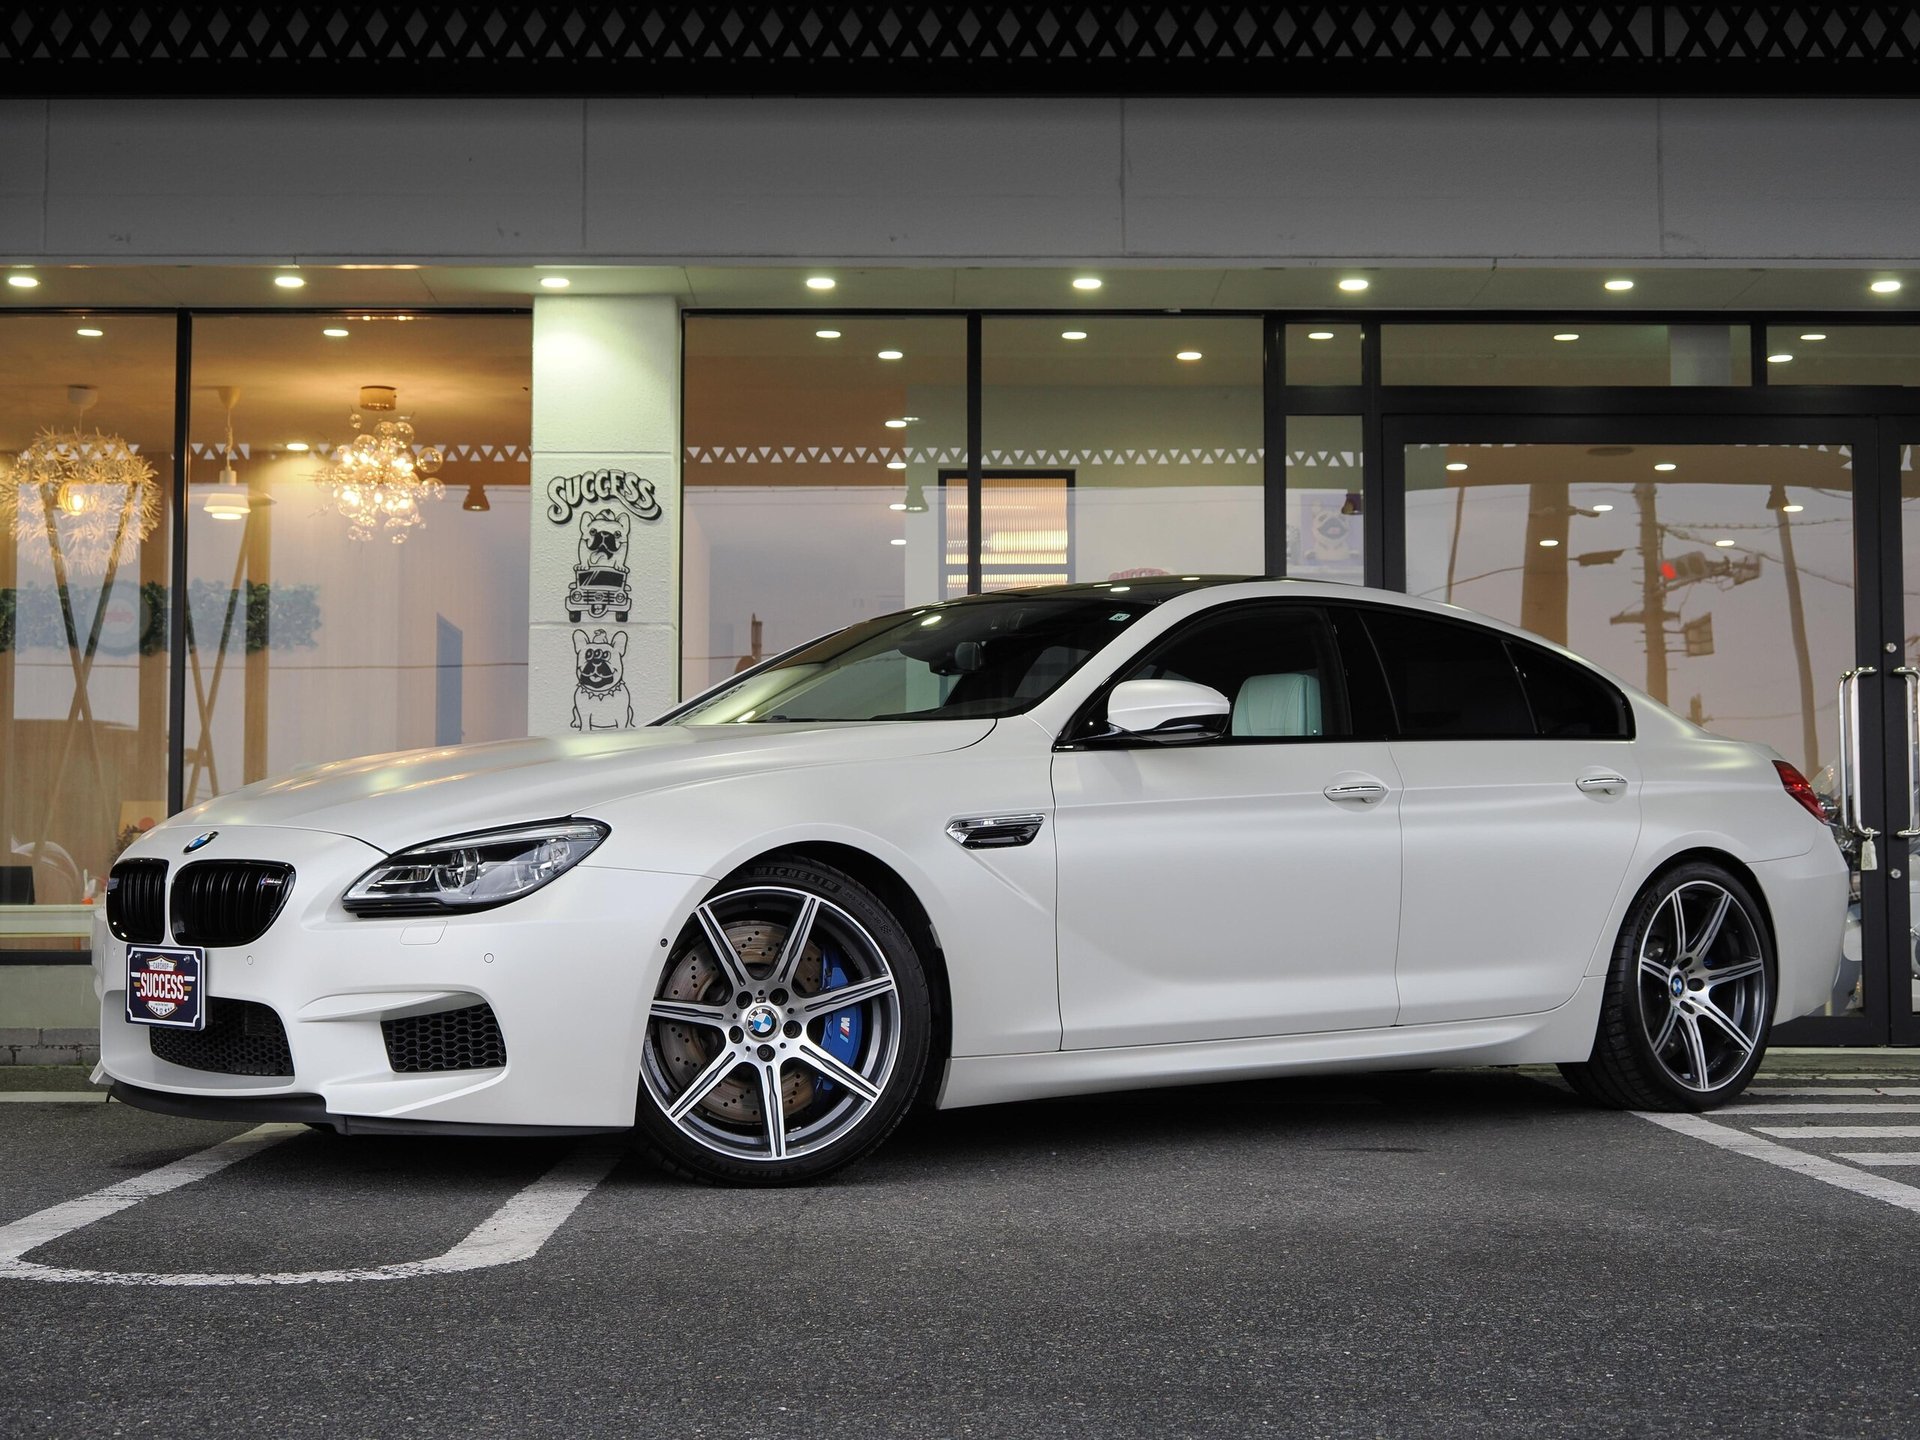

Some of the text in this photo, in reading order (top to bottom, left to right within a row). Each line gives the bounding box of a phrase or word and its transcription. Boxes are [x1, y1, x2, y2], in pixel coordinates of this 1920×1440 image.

[547, 468, 662, 524] SUCCESS
[753, 866, 838, 890] MICHELIN
[140, 972, 184, 1000] SUCCESS
